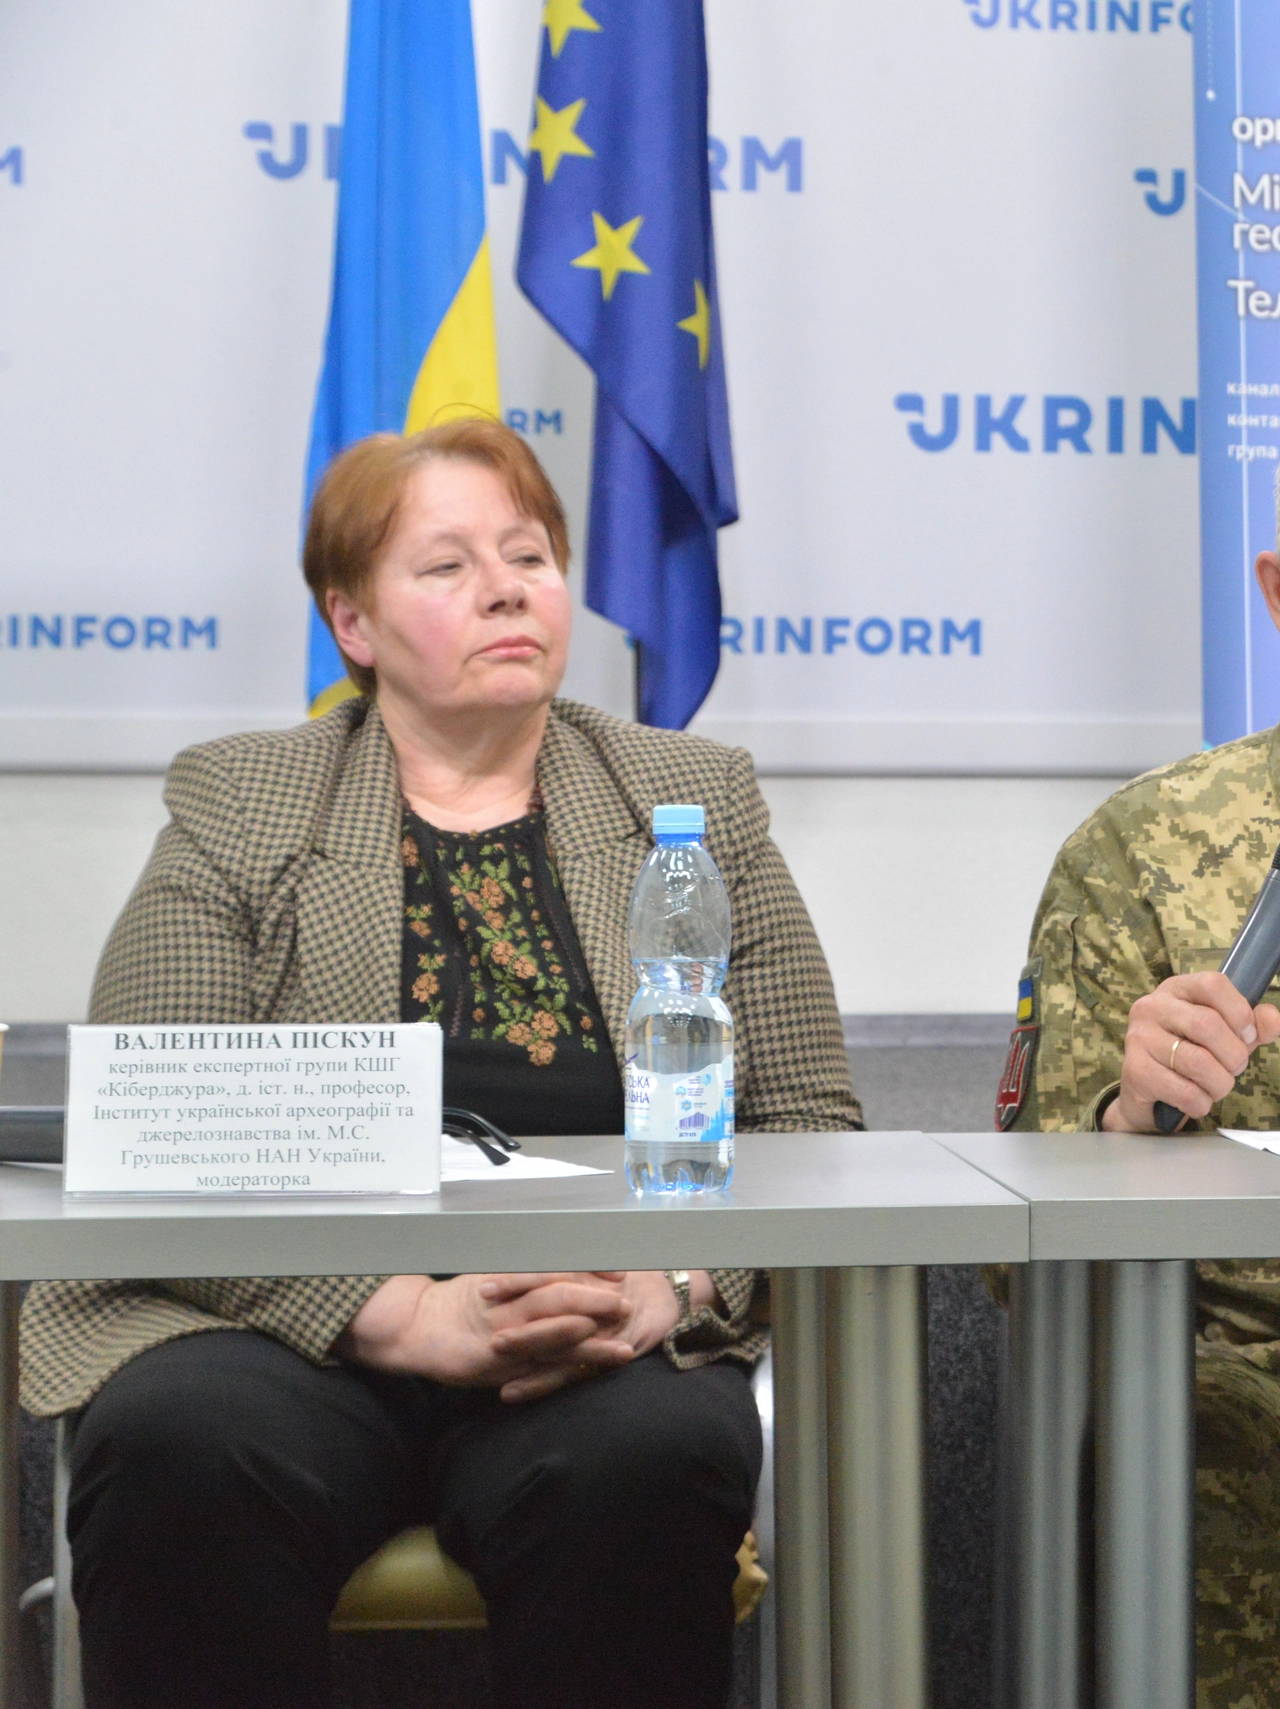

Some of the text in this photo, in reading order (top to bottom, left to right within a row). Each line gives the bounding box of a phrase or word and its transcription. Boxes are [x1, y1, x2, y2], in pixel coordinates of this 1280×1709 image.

[1227, 383, 1280, 396] канал
[894, 393, 1197, 455] UKRIN
[1228, 445, 1278, 461] група
[0, 614, 218, 650] INFORM
[114, 1030, 396, 1051] ВАЛЕНТИНА ПІСКУН
[109, 1057, 401, 1078] керівник експертної групи КШГ
[97, 1079, 411, 1101] «Кіберджура», д. іст. н., професор,
[94, 1101, 414, 1123] Інститут української археографії та
[136, 1125, 369, 1146] джерелознавства ім. М.С.
[121, 1148, 385, 1169] Грушевського НАН України,
[197, 1175, 311, 1190] модераторка
